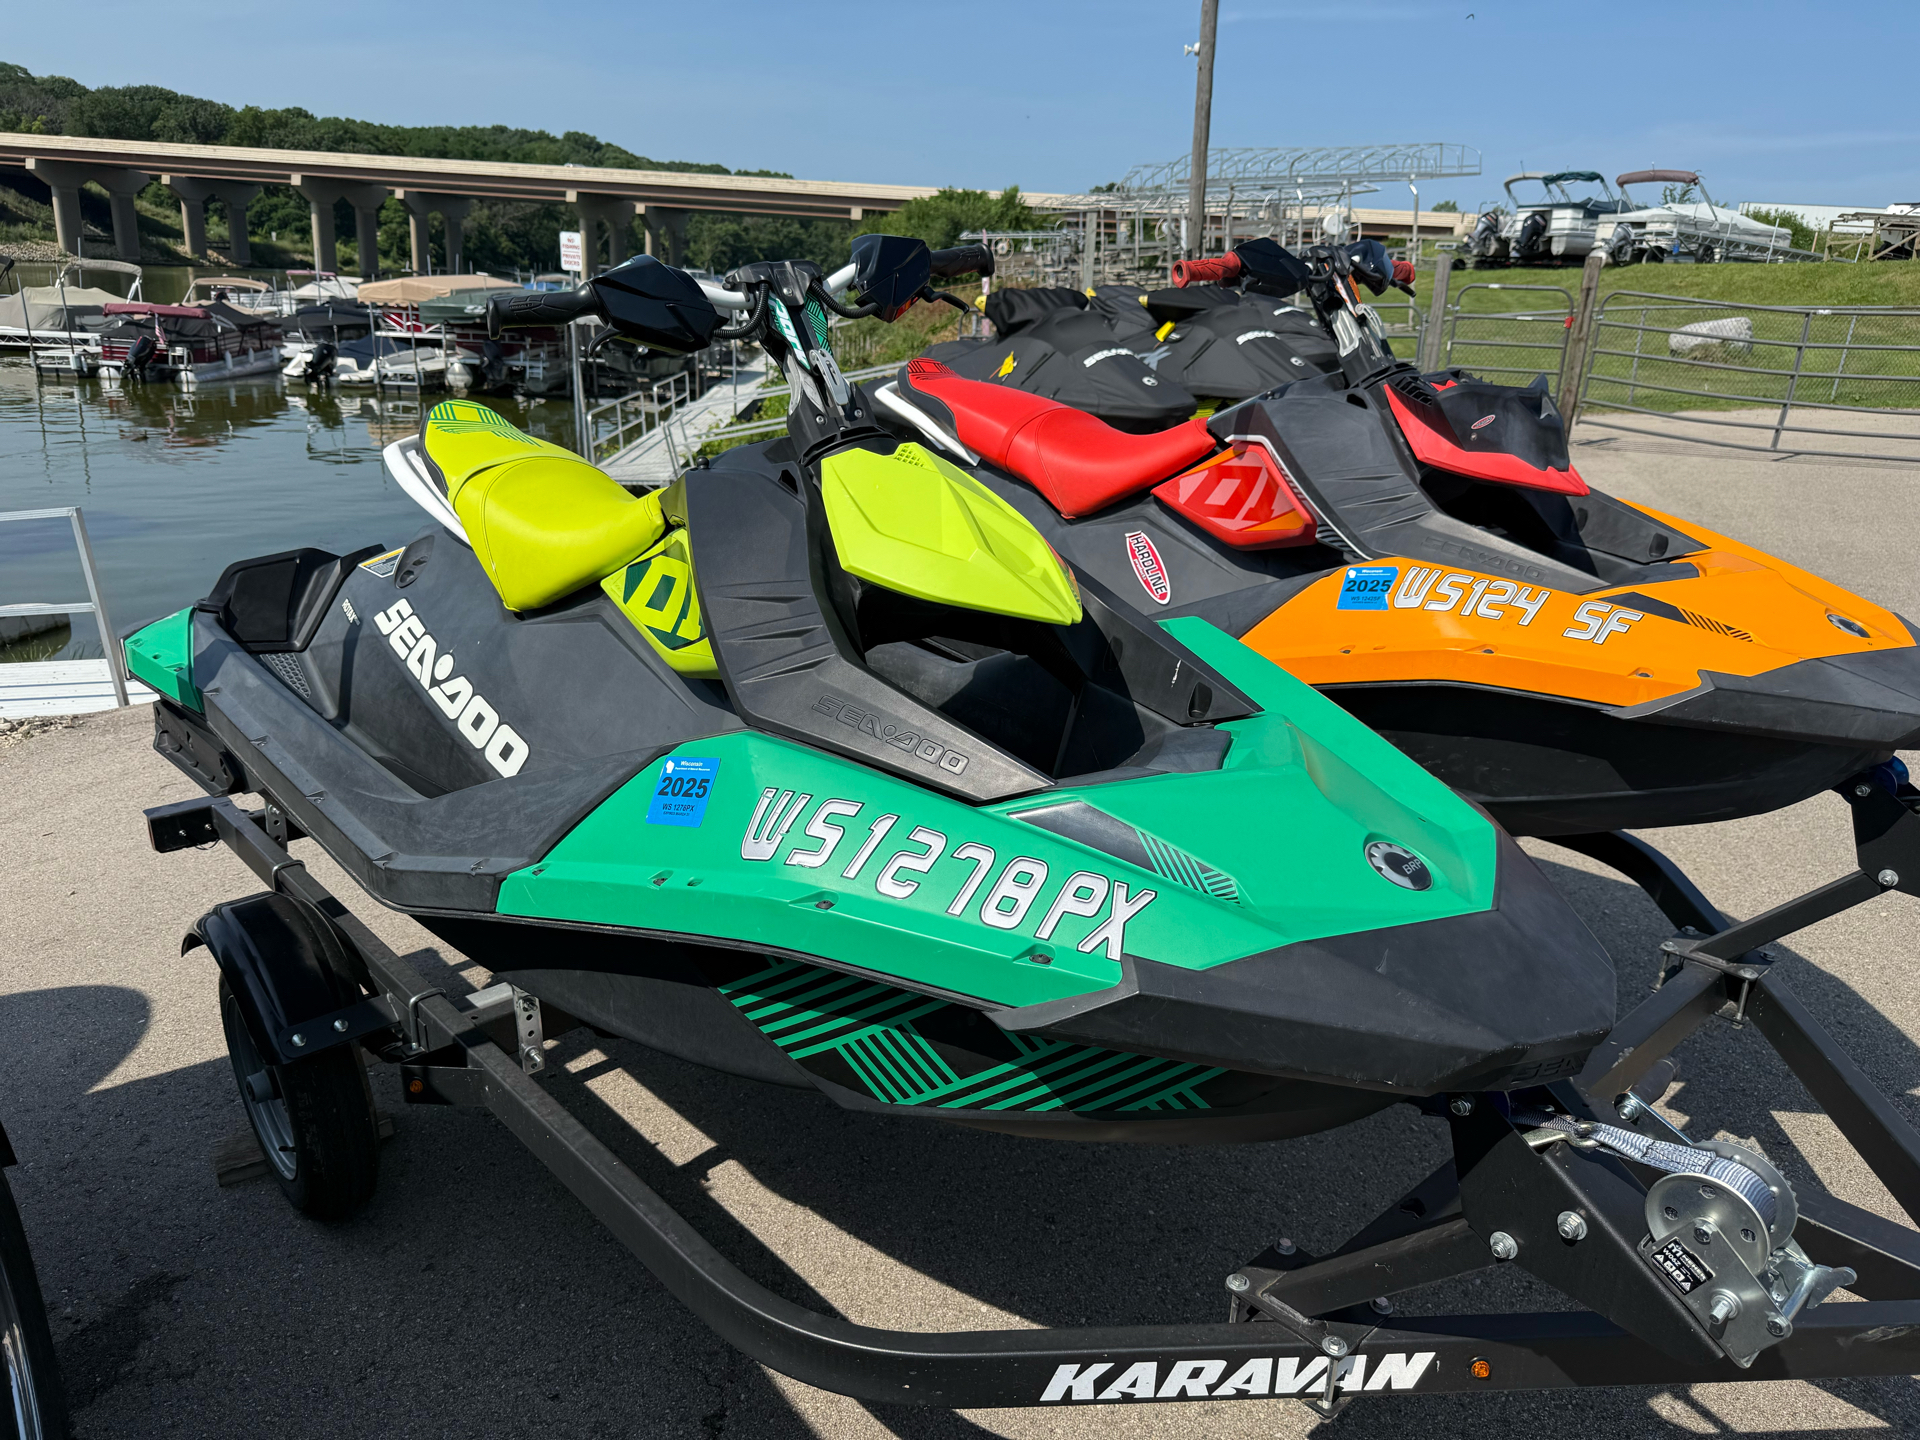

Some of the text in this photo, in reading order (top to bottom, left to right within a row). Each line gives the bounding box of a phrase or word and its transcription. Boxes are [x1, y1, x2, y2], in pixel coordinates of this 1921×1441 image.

[1131, 536, 1168, 595] HARDLINE
[1345, 579, 1392, 592] 2025
[341, 598, 356, 624] ROTAX
[1562, 601, 1645, 645] SF
[657, 777, 711, 798] 2025
[1402, 858, 1421, 875] BRP
[1662, 1247, 1682, 1267] W06Z
[1039, 1351, 1436, 1401] KARAVAN
